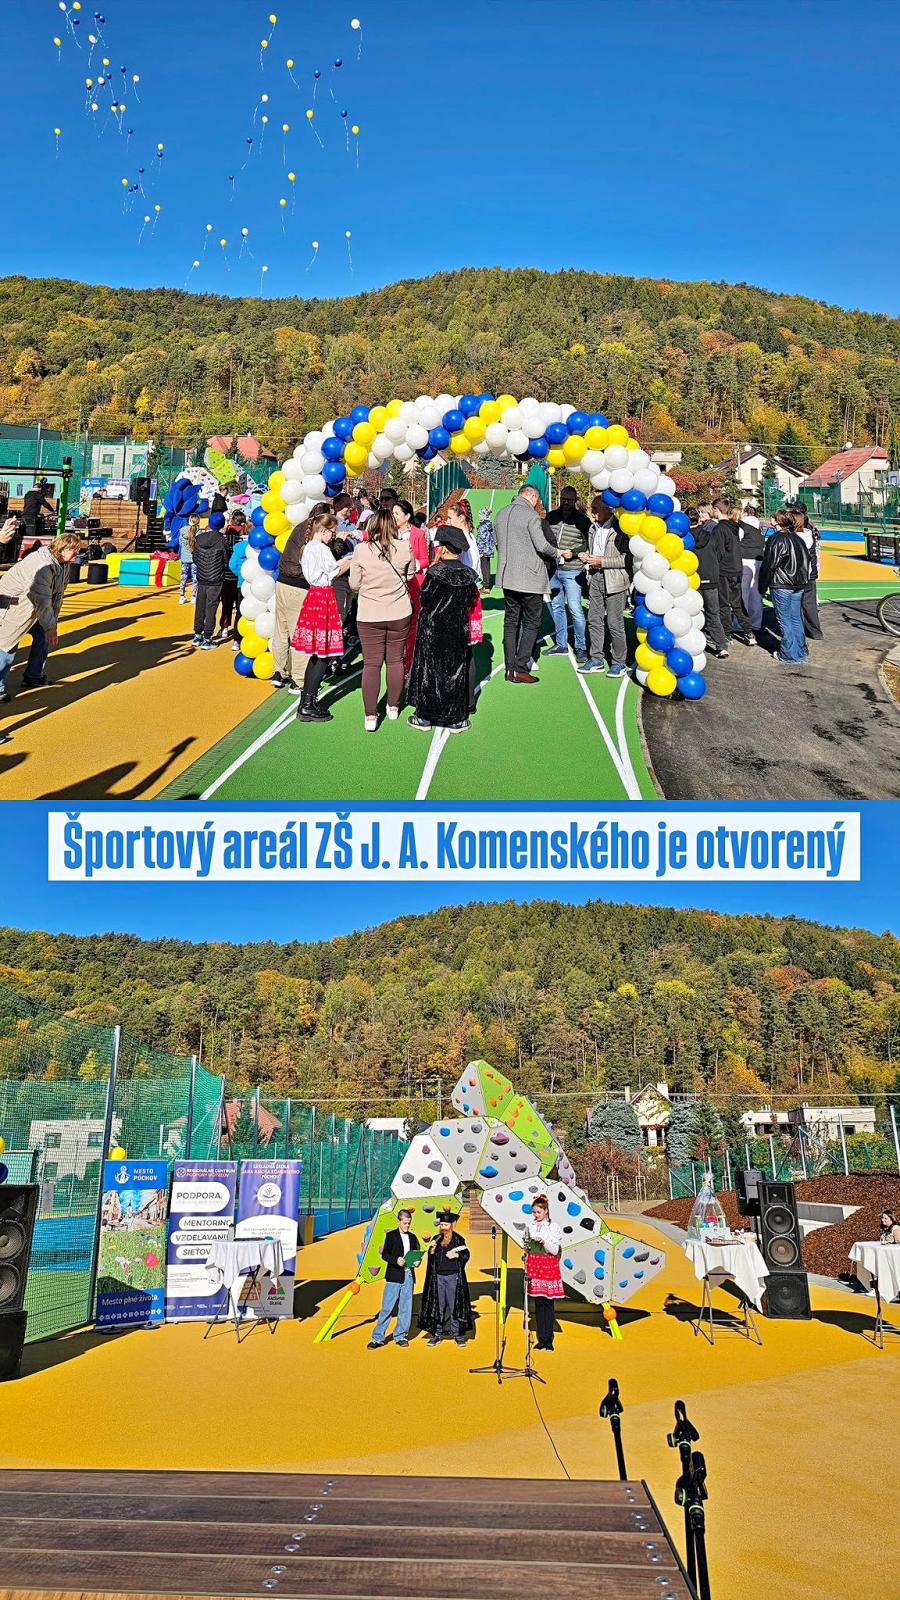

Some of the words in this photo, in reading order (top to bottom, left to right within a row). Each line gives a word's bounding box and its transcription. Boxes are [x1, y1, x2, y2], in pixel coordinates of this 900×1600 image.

[133, 1174, 158, 1182] PÚCHOV
[102, 1298, 123, 1306] Mesto
[123, 1296, 138, 1305] plné
